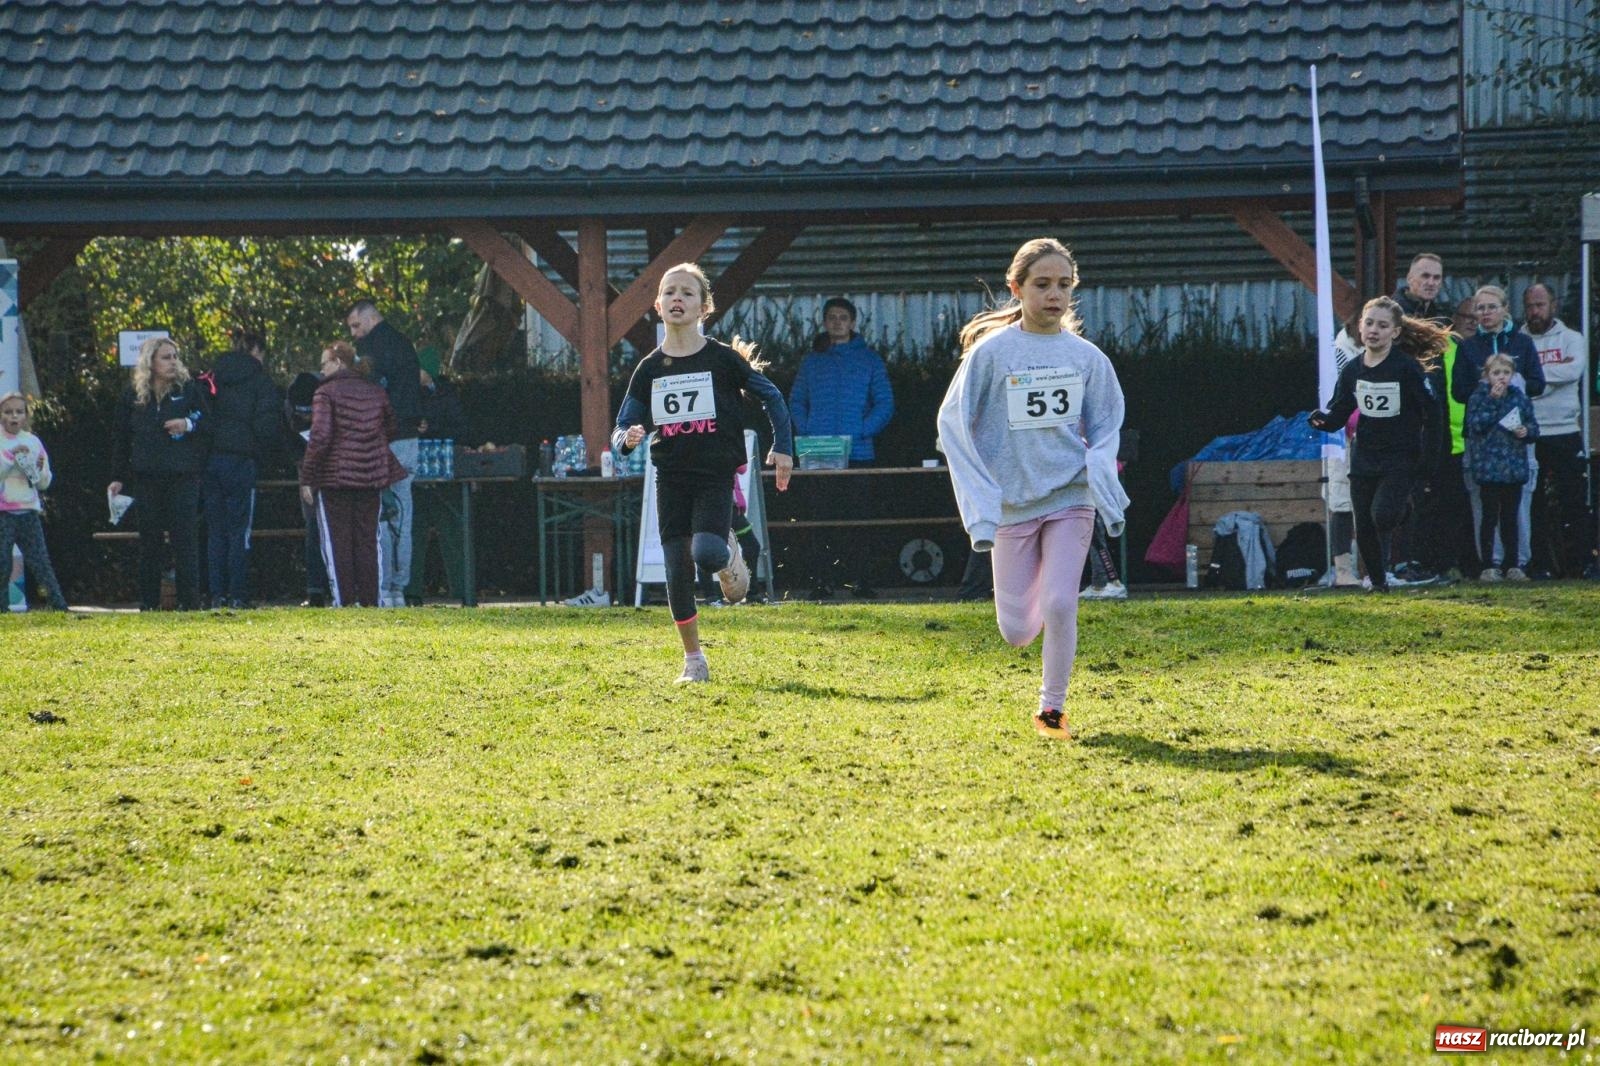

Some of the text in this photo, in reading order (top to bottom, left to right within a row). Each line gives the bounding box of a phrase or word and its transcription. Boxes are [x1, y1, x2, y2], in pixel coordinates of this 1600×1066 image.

[664, 390, 699, 414] 67
[1027, 389, 1069, 417] 53
[1364, 395, 1389, 410] 62
